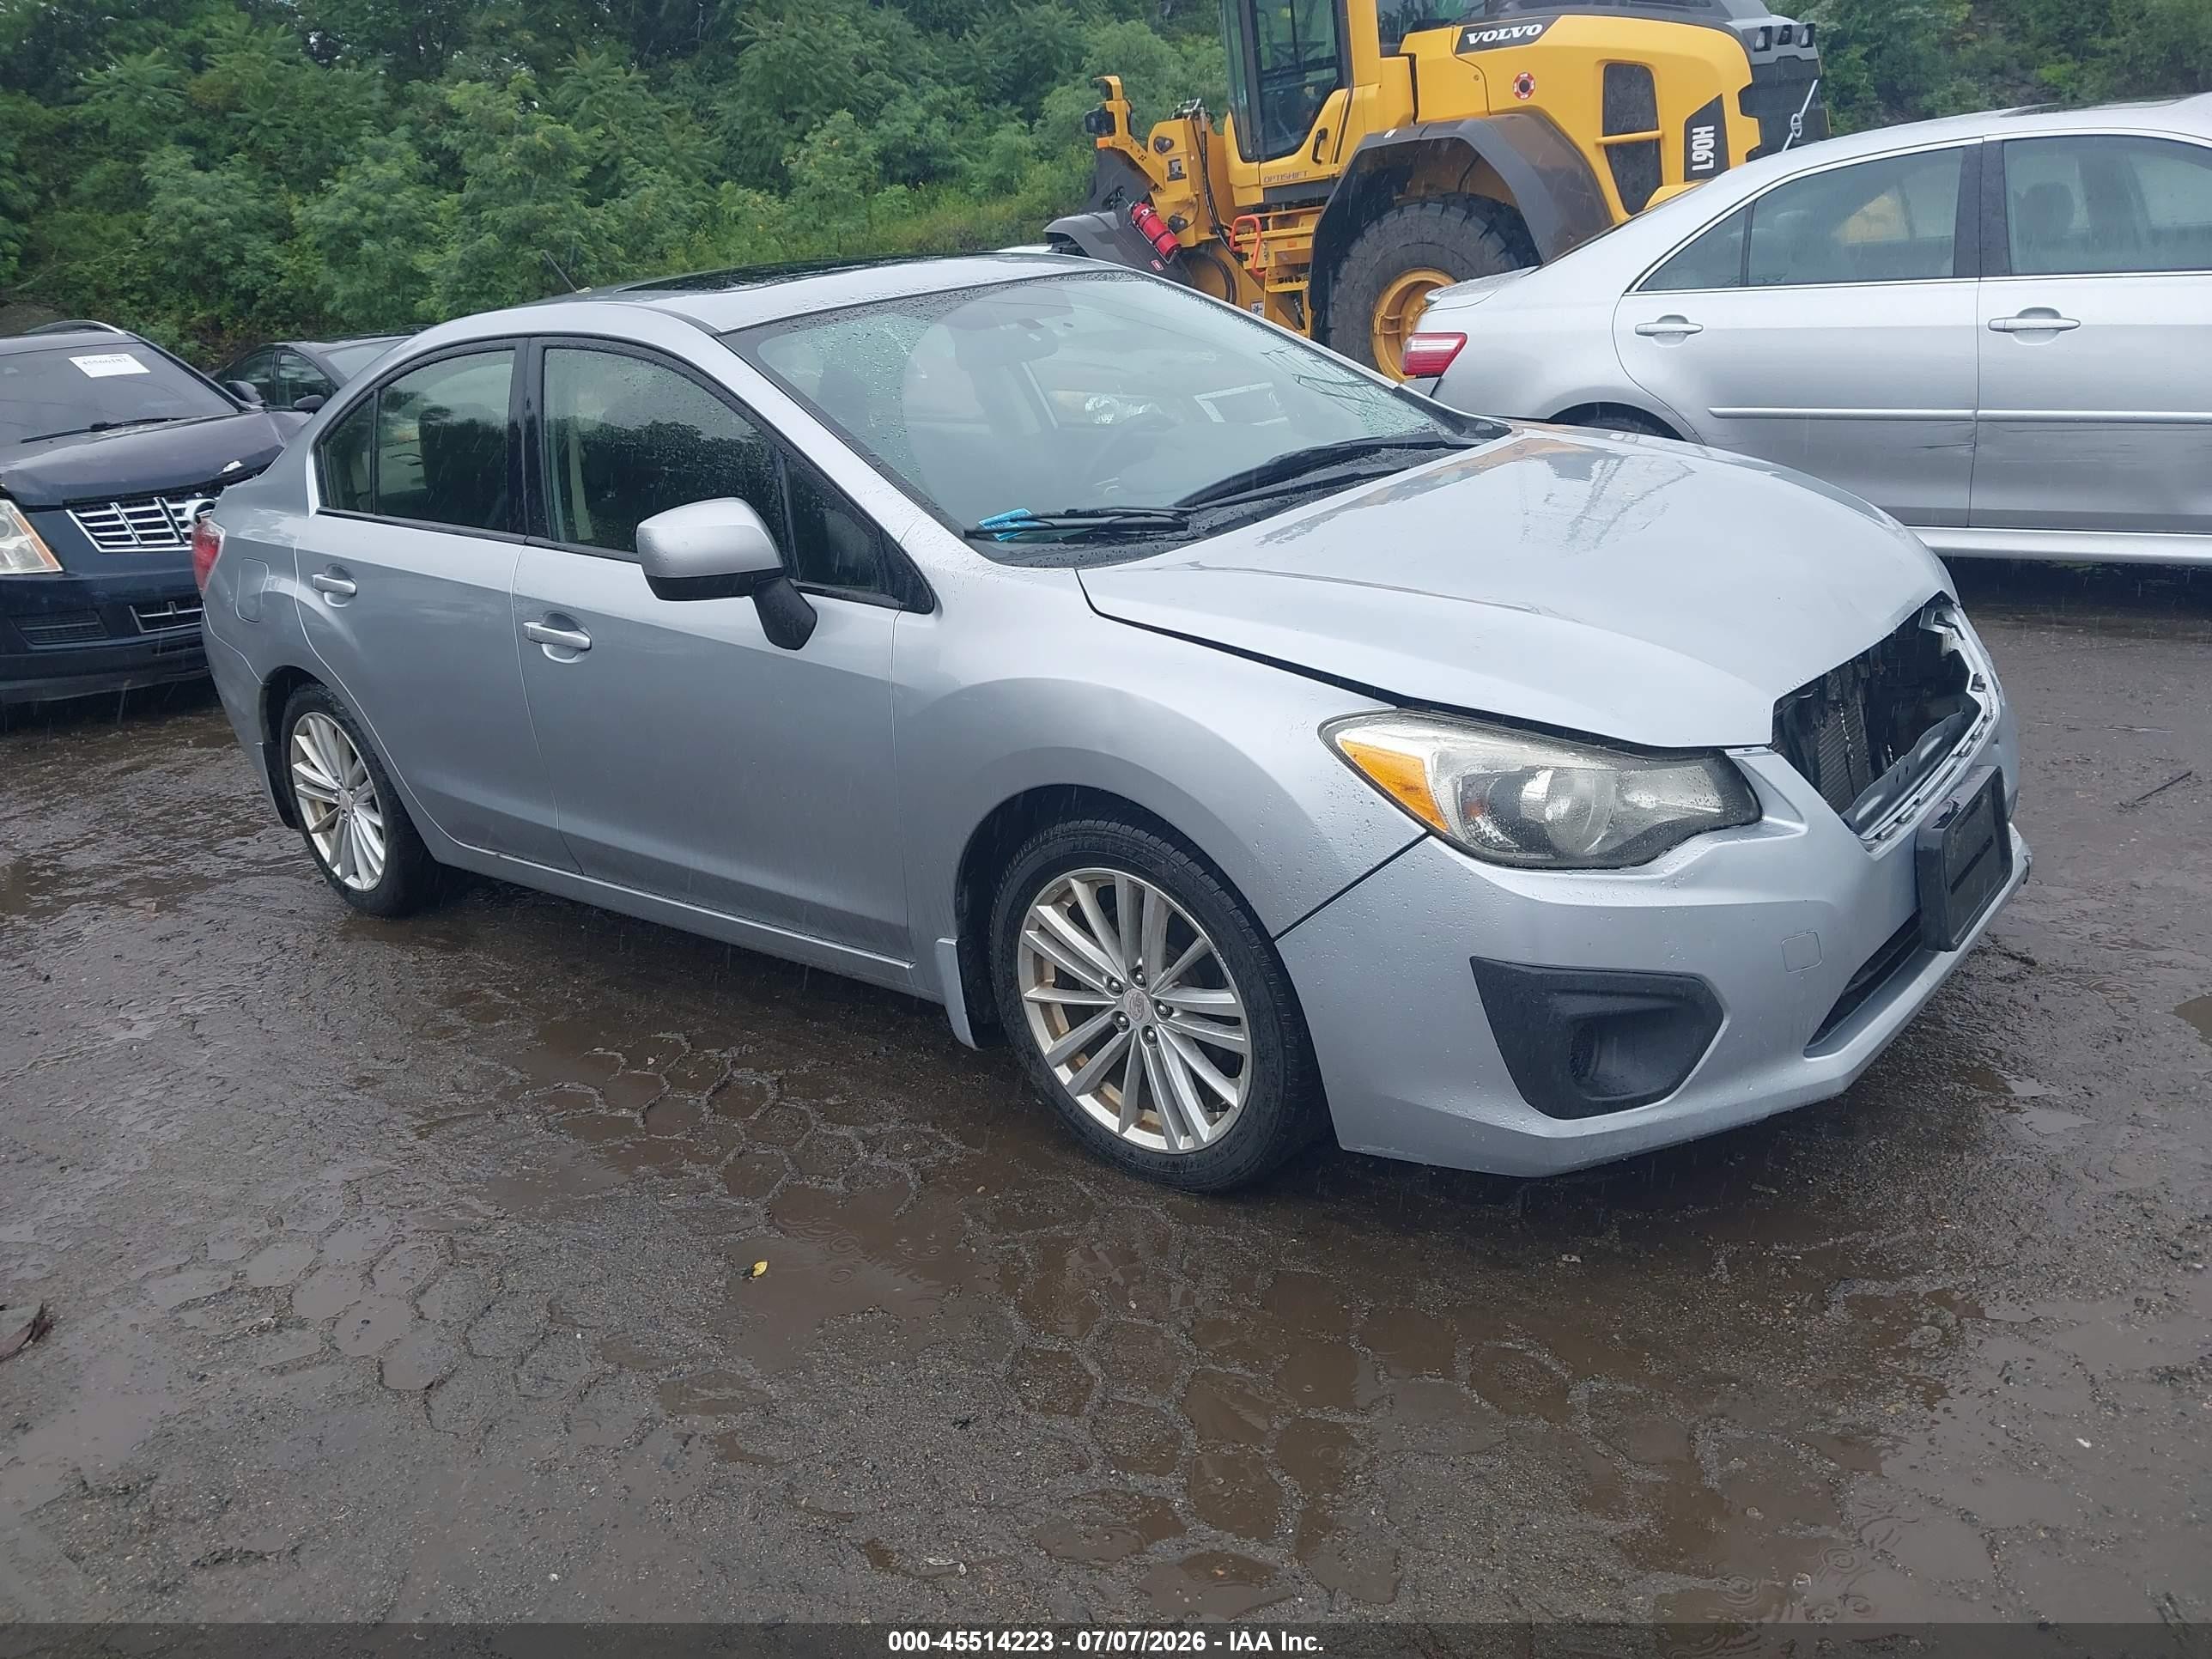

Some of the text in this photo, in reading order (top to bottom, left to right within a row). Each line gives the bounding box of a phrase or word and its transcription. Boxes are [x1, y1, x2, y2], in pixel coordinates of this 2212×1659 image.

[1467, 24, 1543, 45] VOLVO
[1692, 125, 1715, 171] L90H
[1264, 171, 1308, 182] OPTISHIFT
